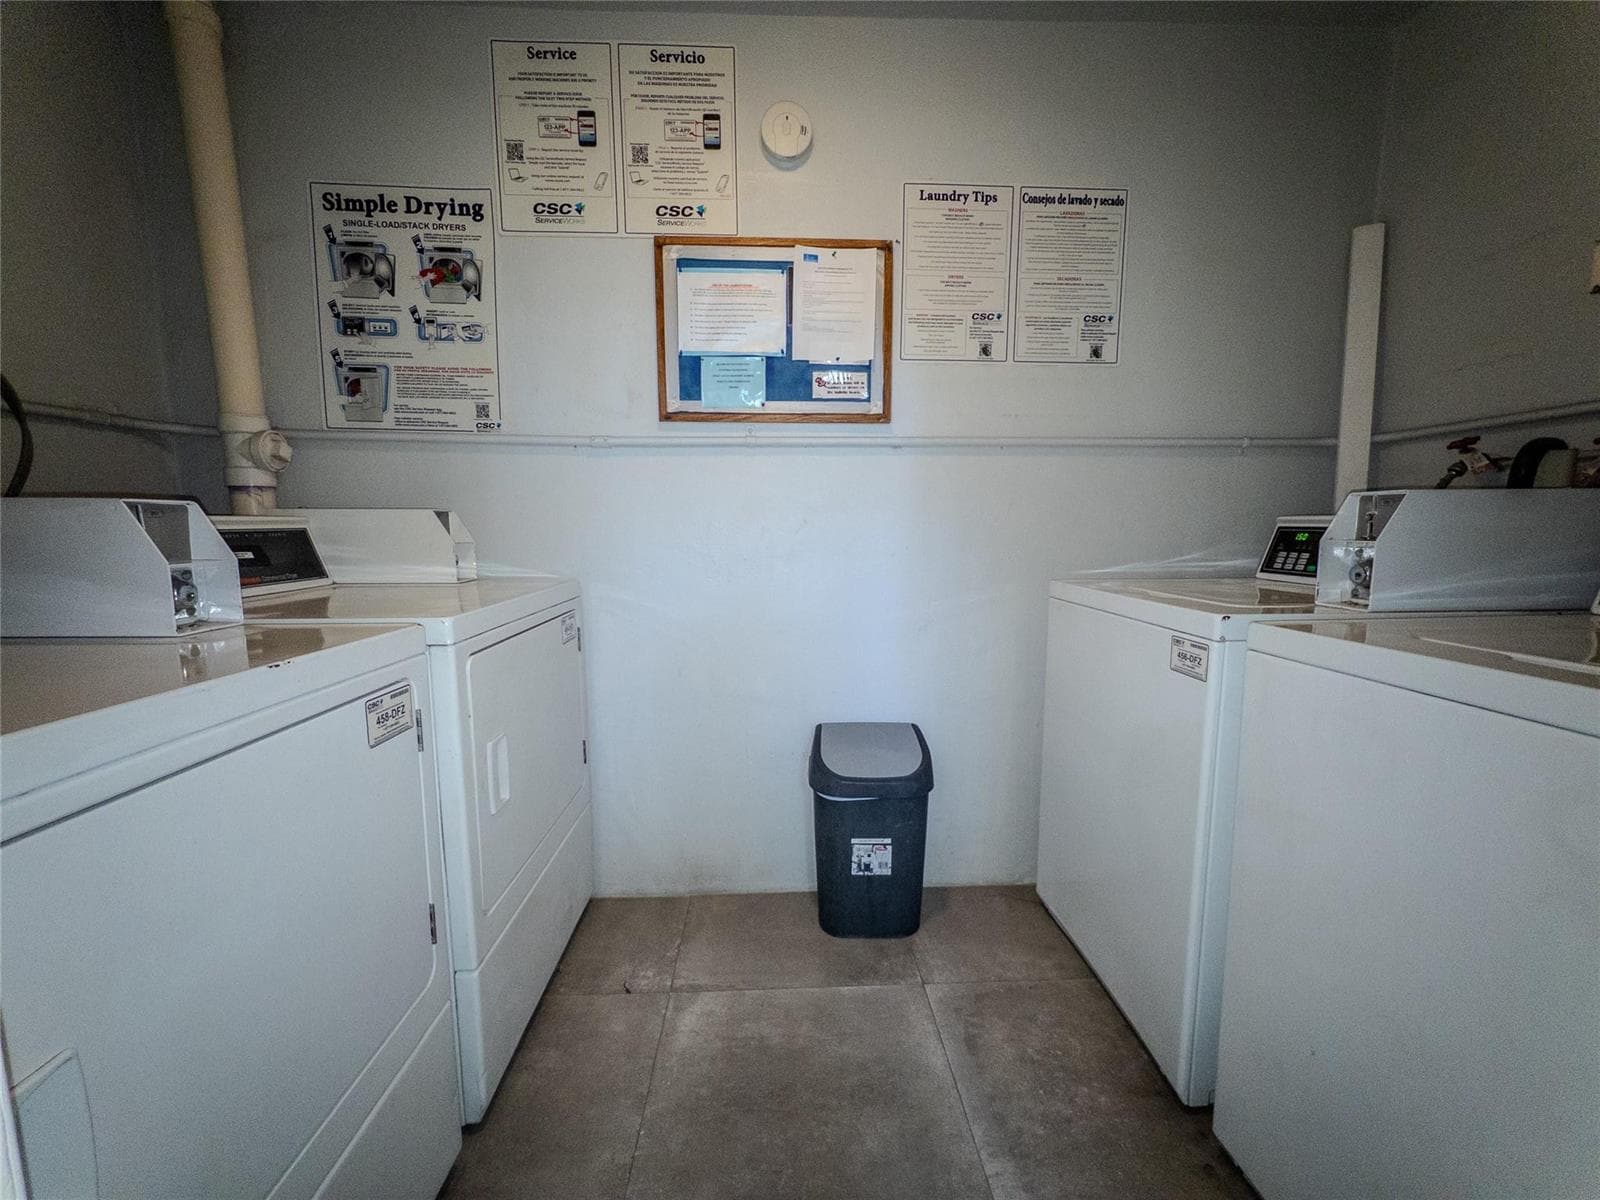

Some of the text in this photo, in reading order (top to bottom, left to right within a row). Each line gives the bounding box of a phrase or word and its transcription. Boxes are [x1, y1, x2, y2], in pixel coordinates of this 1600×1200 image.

[526, 46, 577, 60] Service
[650, 50, 706, 64] Servicio
[919, 189, 998, 206] Laundry Tips
[1022, 192, 1125, 209] Consejos de lavado y secado
[321, 191, 485, 223] Simple Drying
[533, 203, 573, 215] CSC
[655, 205, 694, 217] CSC
[342, 219, 467, 232] SINGLE-LOAD/STACK DRYERS
[971, 312, 995, 321] CSC
[1083, 314, 1107, 323] CSC
[475, 422, 496, 430] CSC
[375, 704, 406, 726] 458-DFZ
